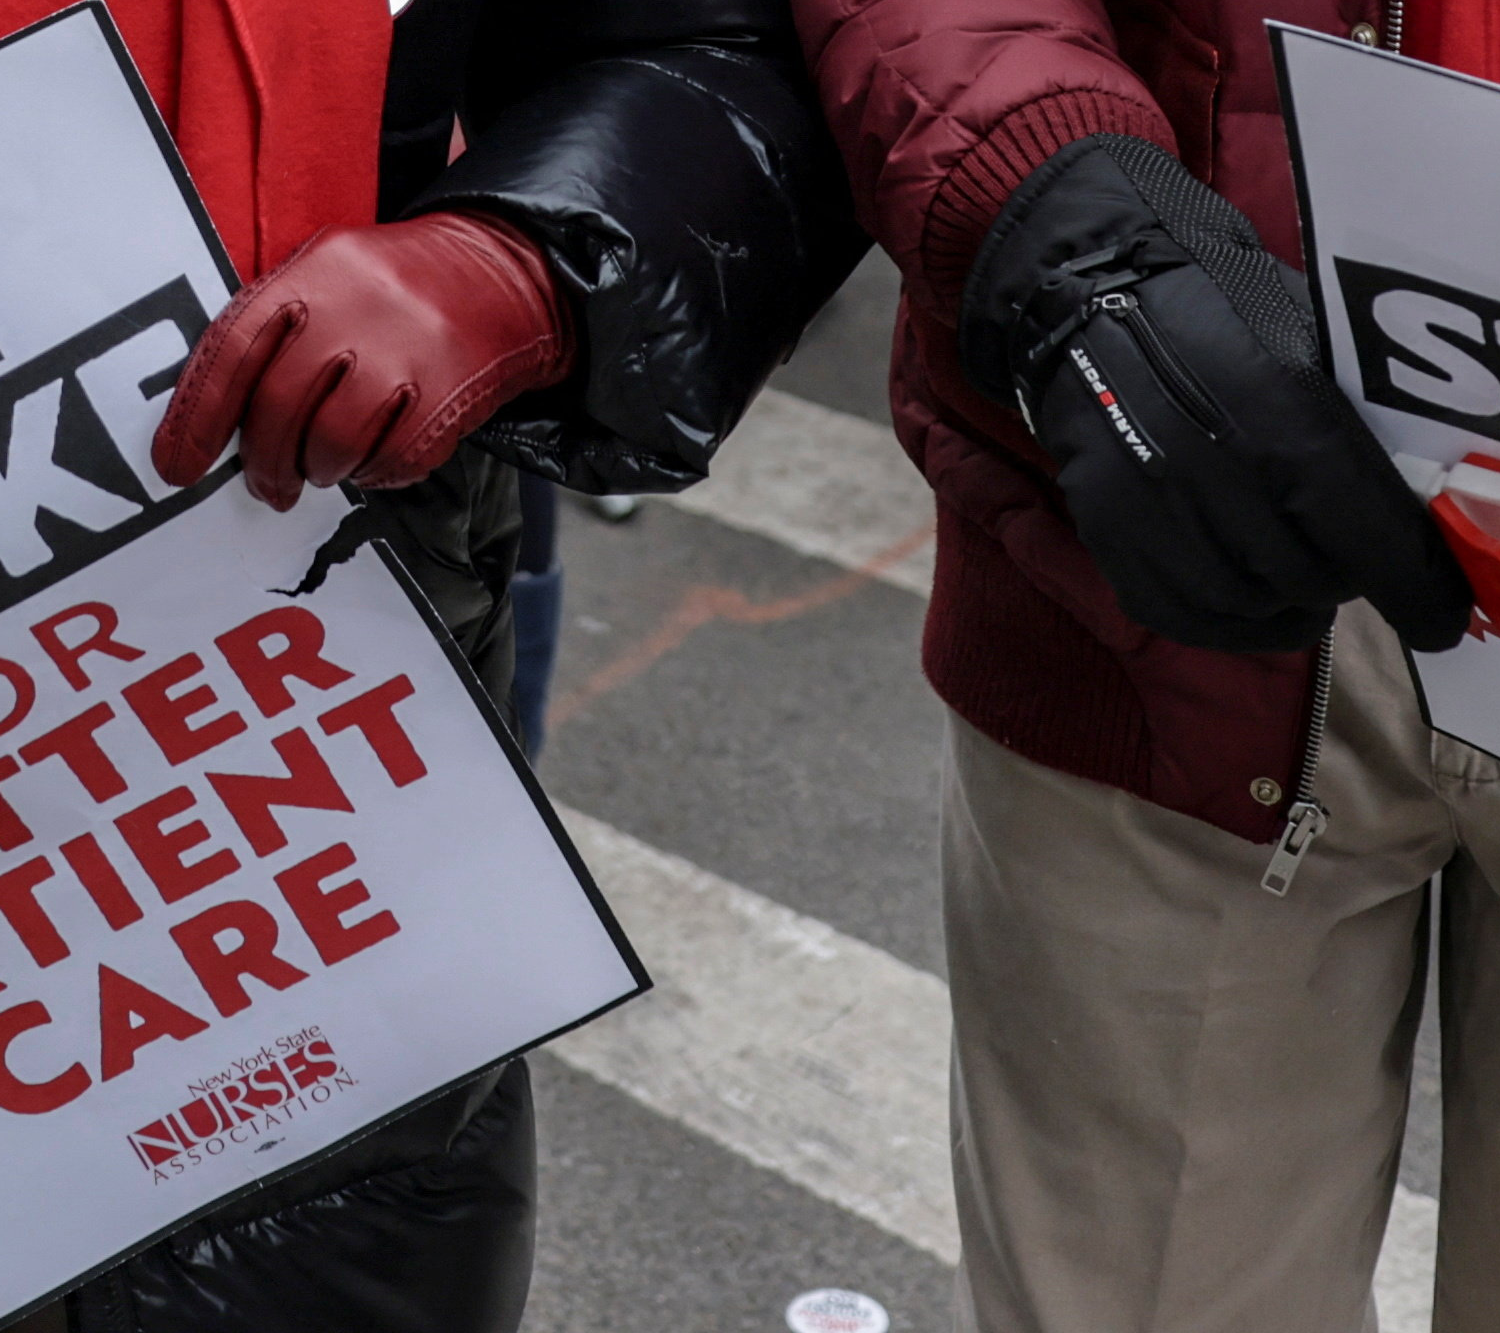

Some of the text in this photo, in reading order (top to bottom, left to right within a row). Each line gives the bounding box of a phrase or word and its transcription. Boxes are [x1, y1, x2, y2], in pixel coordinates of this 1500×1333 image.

[1070, 348, 1152, 463] WARMSPORT
[127, 1036, 340, 1171] NURSES
[187, 1024, 322, 1098] New York State
[153, 1069, 356, 1186] ASSOCIATION
